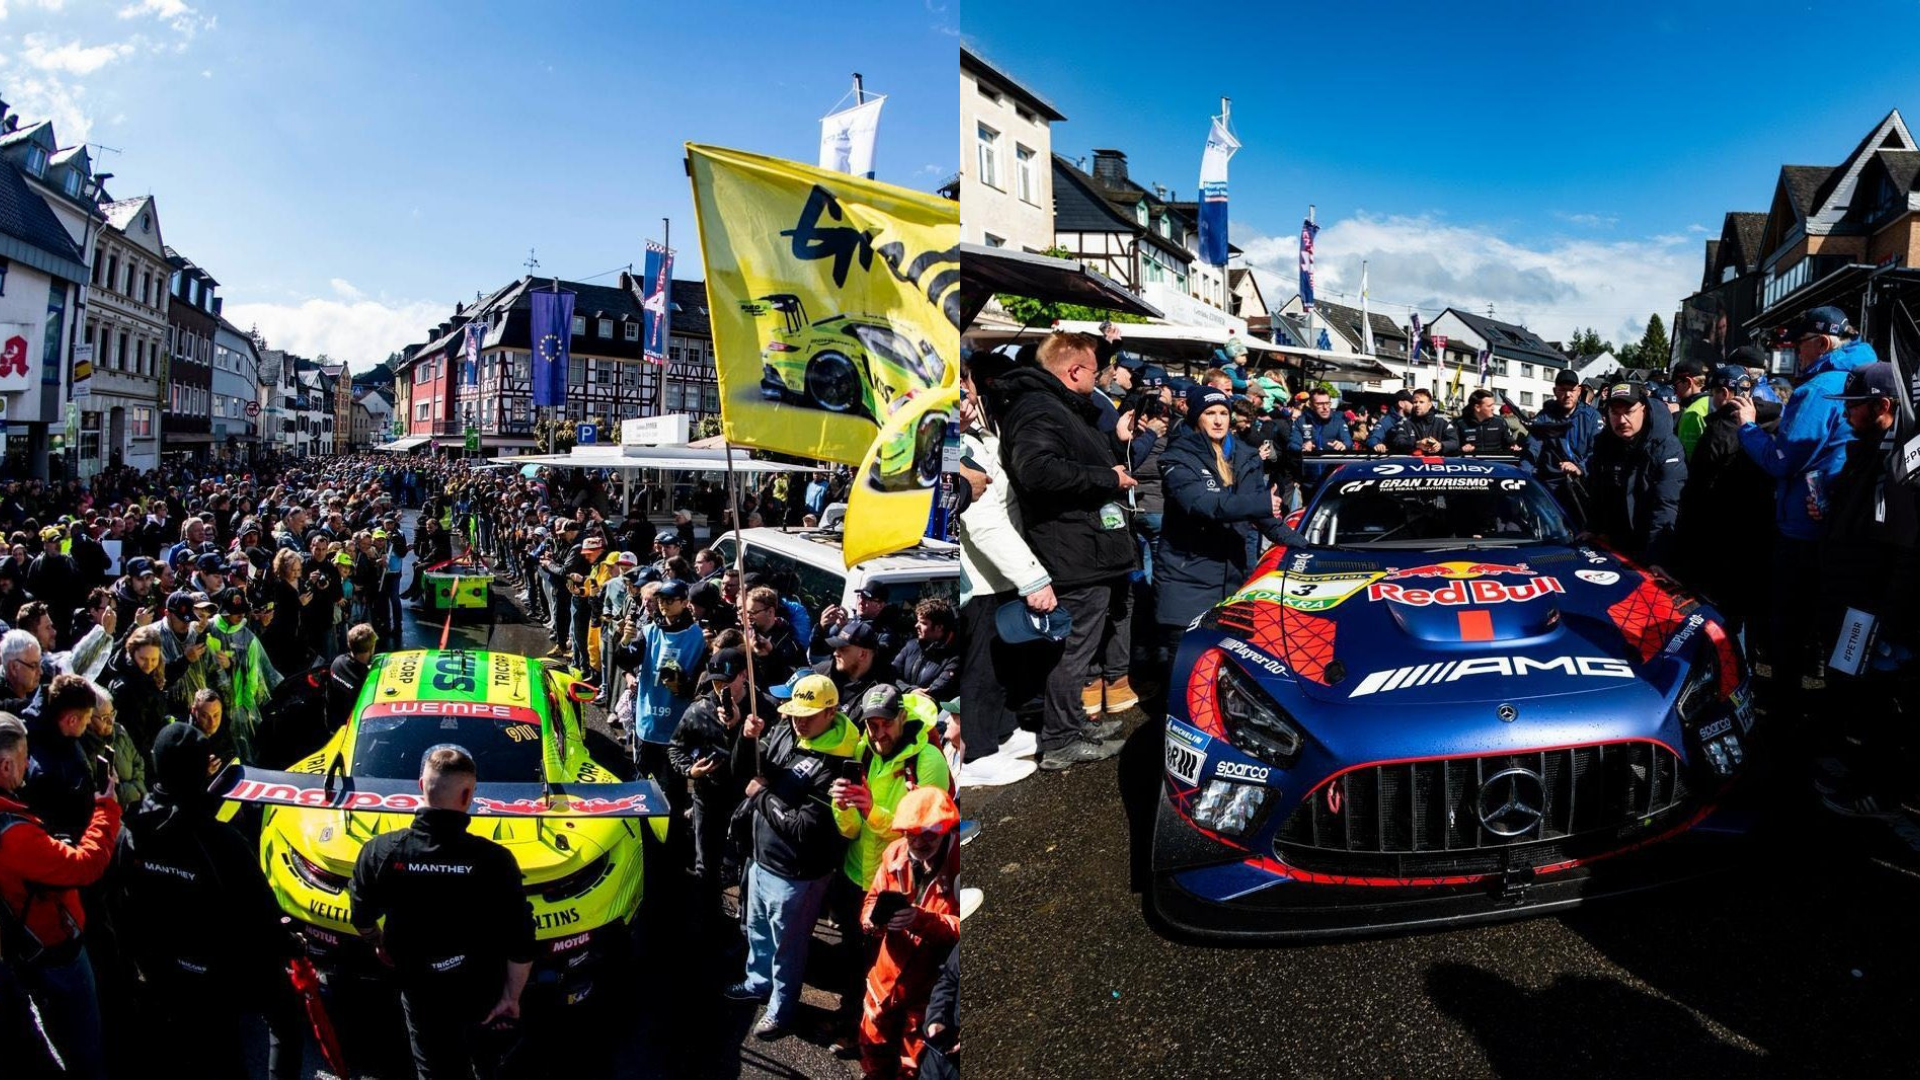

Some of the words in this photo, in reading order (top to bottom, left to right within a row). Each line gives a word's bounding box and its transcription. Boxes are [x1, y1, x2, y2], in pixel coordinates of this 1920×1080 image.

[581, 426, 593, 442] P
[1409, 464, 1494, 473] viaplay
[1379, 478, 1423, 488] GRAN
[1425, 478, 1490, 487] TURISMO
[1291, 584, 1318, 597] 3
[1367, 580, 1470, 607] Red
[1469, 576, 1566, 604] Bull
[1253, 591, 1325, 609] DEKRA
[1445, 656, 1635, 682] AMG
[390, 702, 511, 717] WEMPE
[505, 724, 539, 743] 911
[1171, 724, 1204, 745] MICHELIN
[1700, 717, 1731, 738] sparco
[1215, 761, 1269, 779] sparco
[144, 861, 196, 881] MANTHEY
[408, 863, 473, 874] MANTHEY
[553, 932, 591, 952] MOTUL
[431, 954, 466, 969] TRICORP
